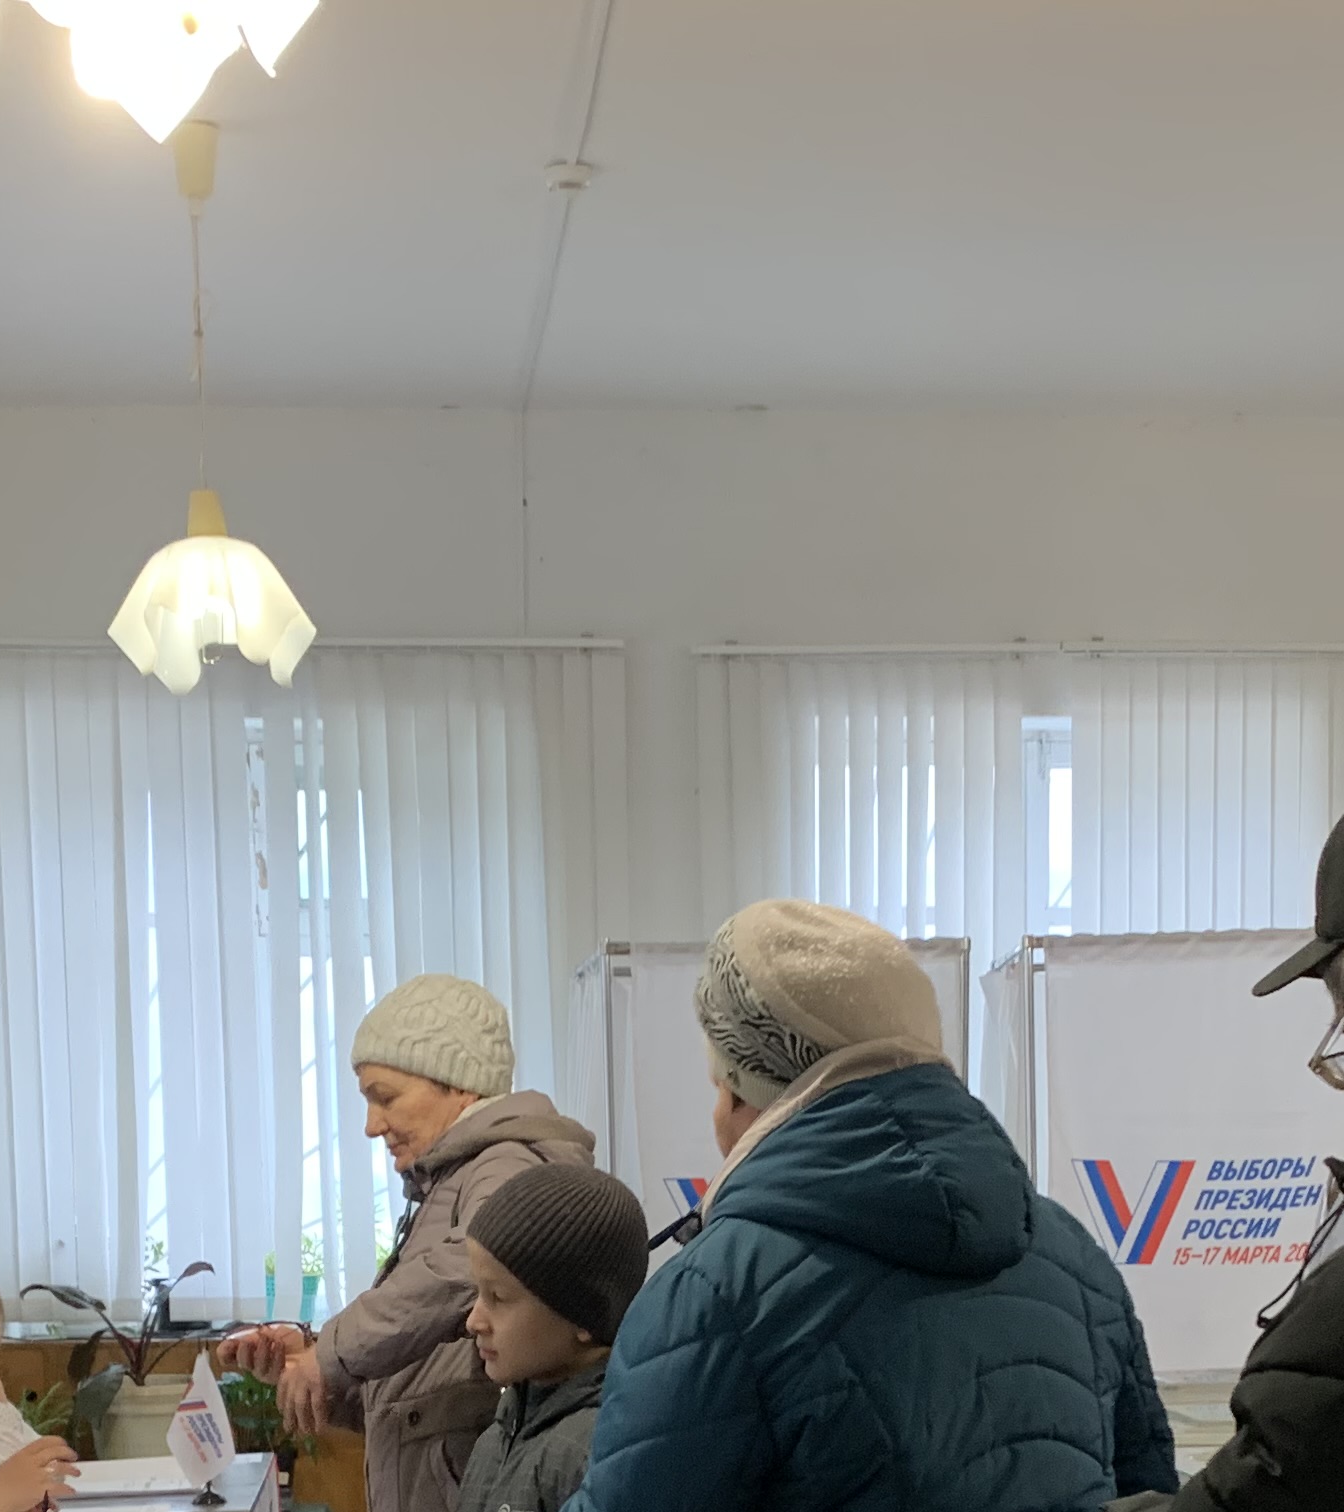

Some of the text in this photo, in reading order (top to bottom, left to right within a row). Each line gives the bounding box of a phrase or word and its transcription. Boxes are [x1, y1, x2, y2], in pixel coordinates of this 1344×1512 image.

[1206, 1156, 1317, 1182] ВЫБОРЫ
[1194, 1184, 1323, 1212] ПРЕЗИДЕН
[1181, 1217, 1282, 1240] РОССИИ
[1221, 1245, 1282, 1265] МАРТА
[1284, 1242, 1308, 1263] 20
